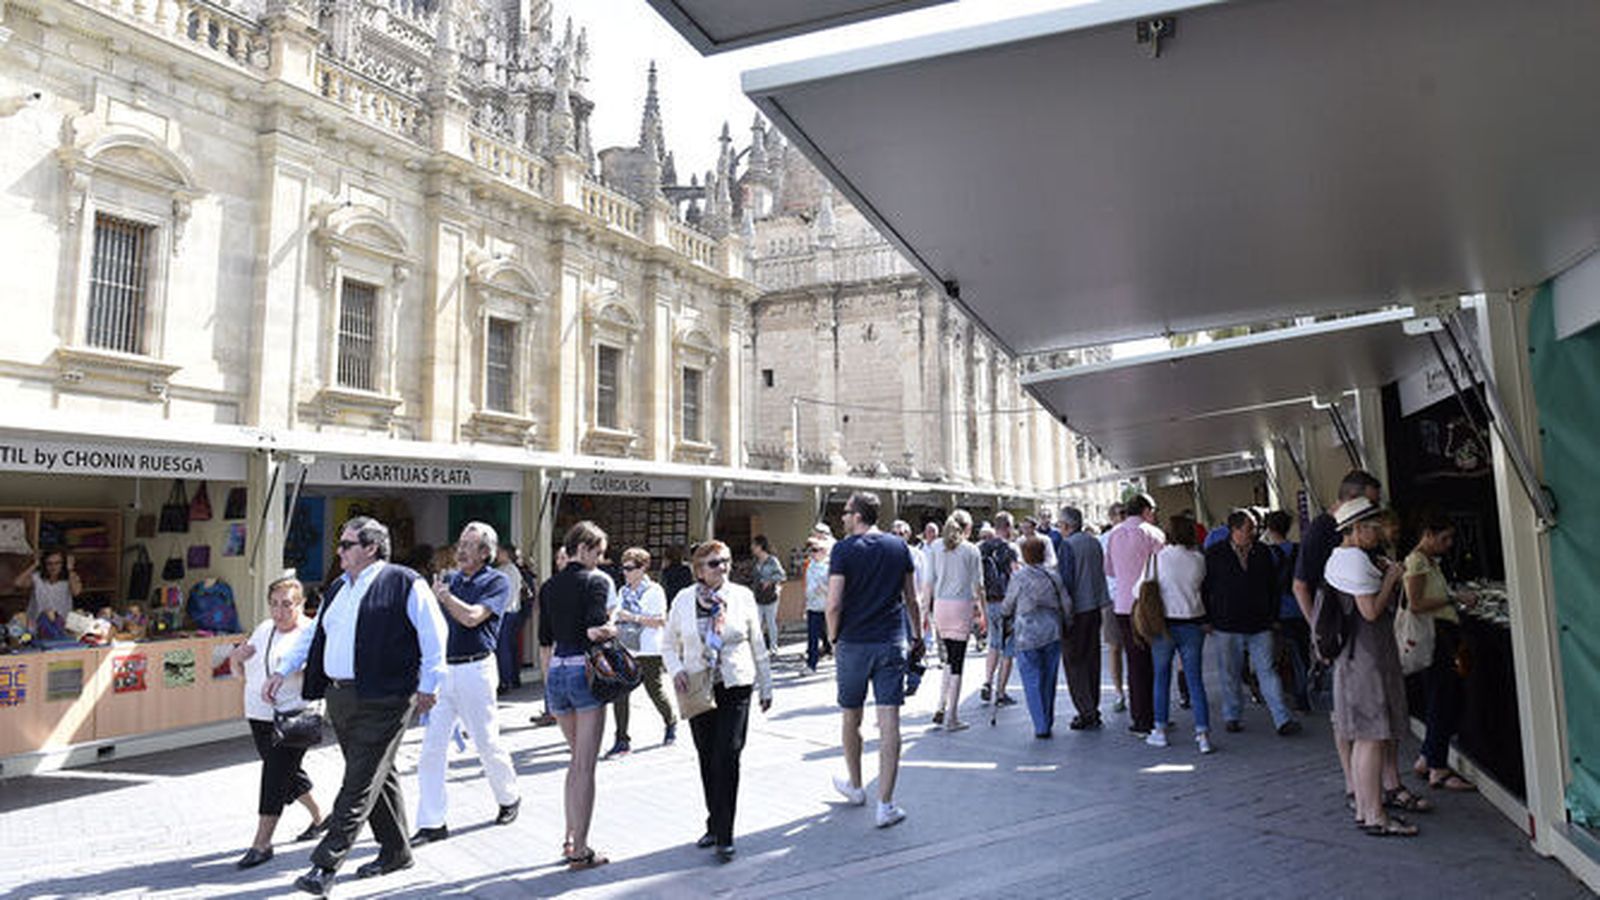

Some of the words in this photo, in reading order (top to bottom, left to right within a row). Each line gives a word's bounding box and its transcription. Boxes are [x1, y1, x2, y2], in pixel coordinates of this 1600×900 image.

[34, 448, 57, 469] by
[62, 450, 136, 469] CHONIN
[139, 454, 204, 473] RUESGA
[431, 467, 472, 485] PLATA
